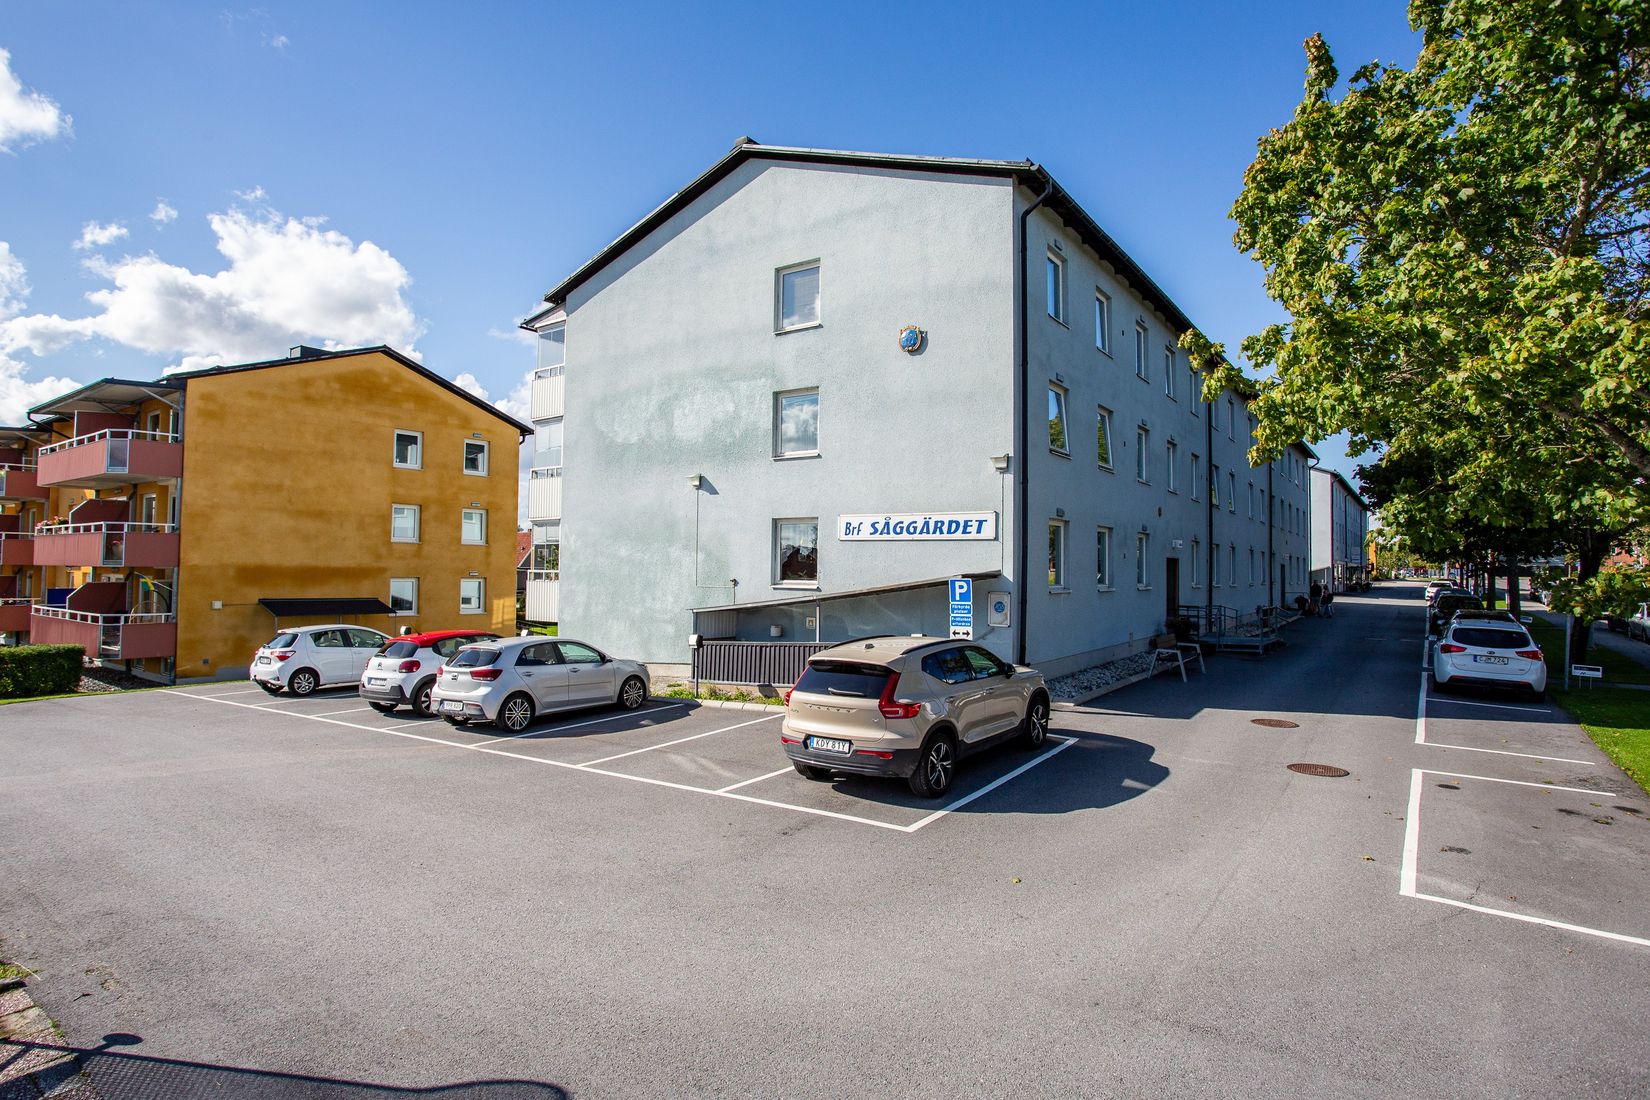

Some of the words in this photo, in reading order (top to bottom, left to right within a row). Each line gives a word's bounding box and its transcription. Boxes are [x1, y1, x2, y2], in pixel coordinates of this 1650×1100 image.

[844, 521, 863, 536] Brf
[869, 516, 988, 536] SÅGGÄRDET
[955, 581, 968, 601] P
[815, 740, 830, 748] KDY
[832, 741, 847, 750] 81Y
